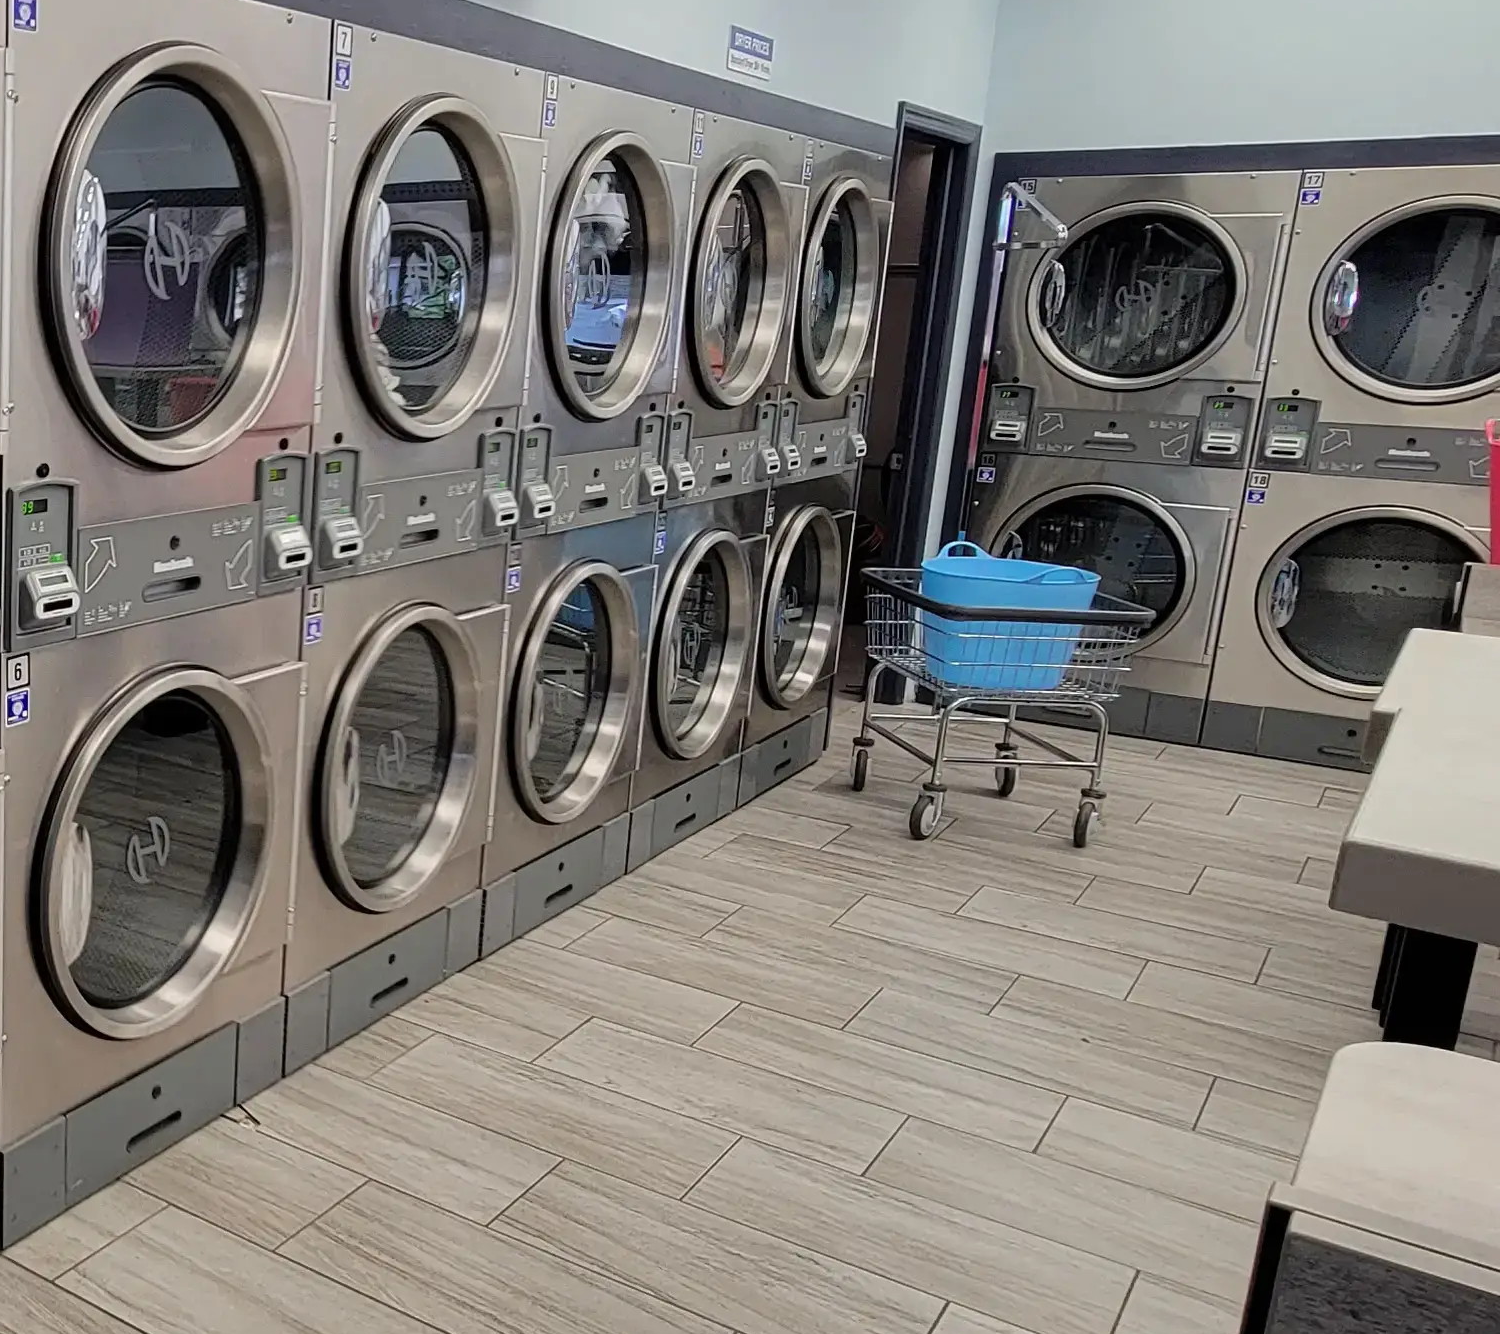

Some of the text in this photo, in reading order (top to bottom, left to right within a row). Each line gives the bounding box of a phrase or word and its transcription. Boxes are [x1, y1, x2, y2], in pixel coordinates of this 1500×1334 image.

[341, 31, 347, 50] 7
[1307, 175, 1321, 185] 17
[1022, 182, 1034, 191] 15
[1253, 475, 1267, 485] 18
[14, 662, 22, 681] 6
